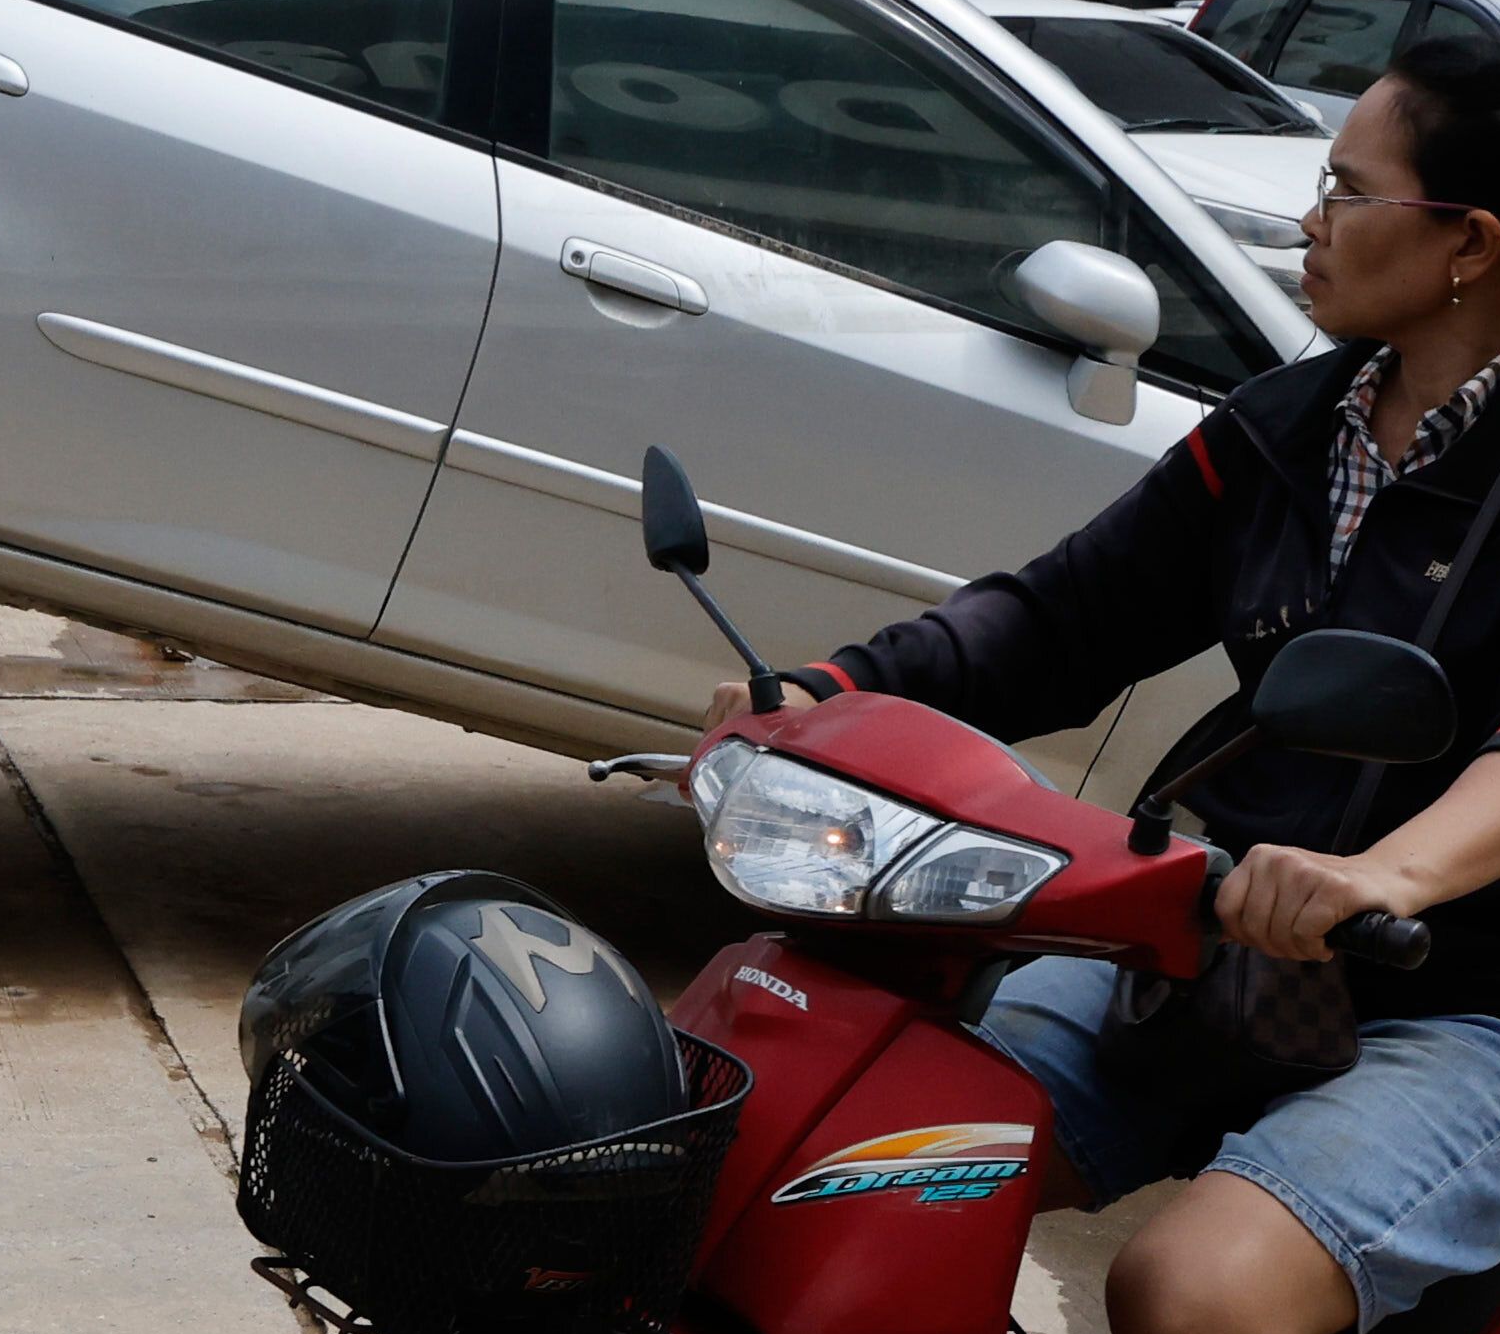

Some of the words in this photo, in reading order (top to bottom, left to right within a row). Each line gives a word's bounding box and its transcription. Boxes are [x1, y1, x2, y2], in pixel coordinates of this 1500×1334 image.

[734, 966, 808, 1011] HONDA
[804, 1162, 1022, 1198] Dream
[916, 1182, 1001, 1203] 125
